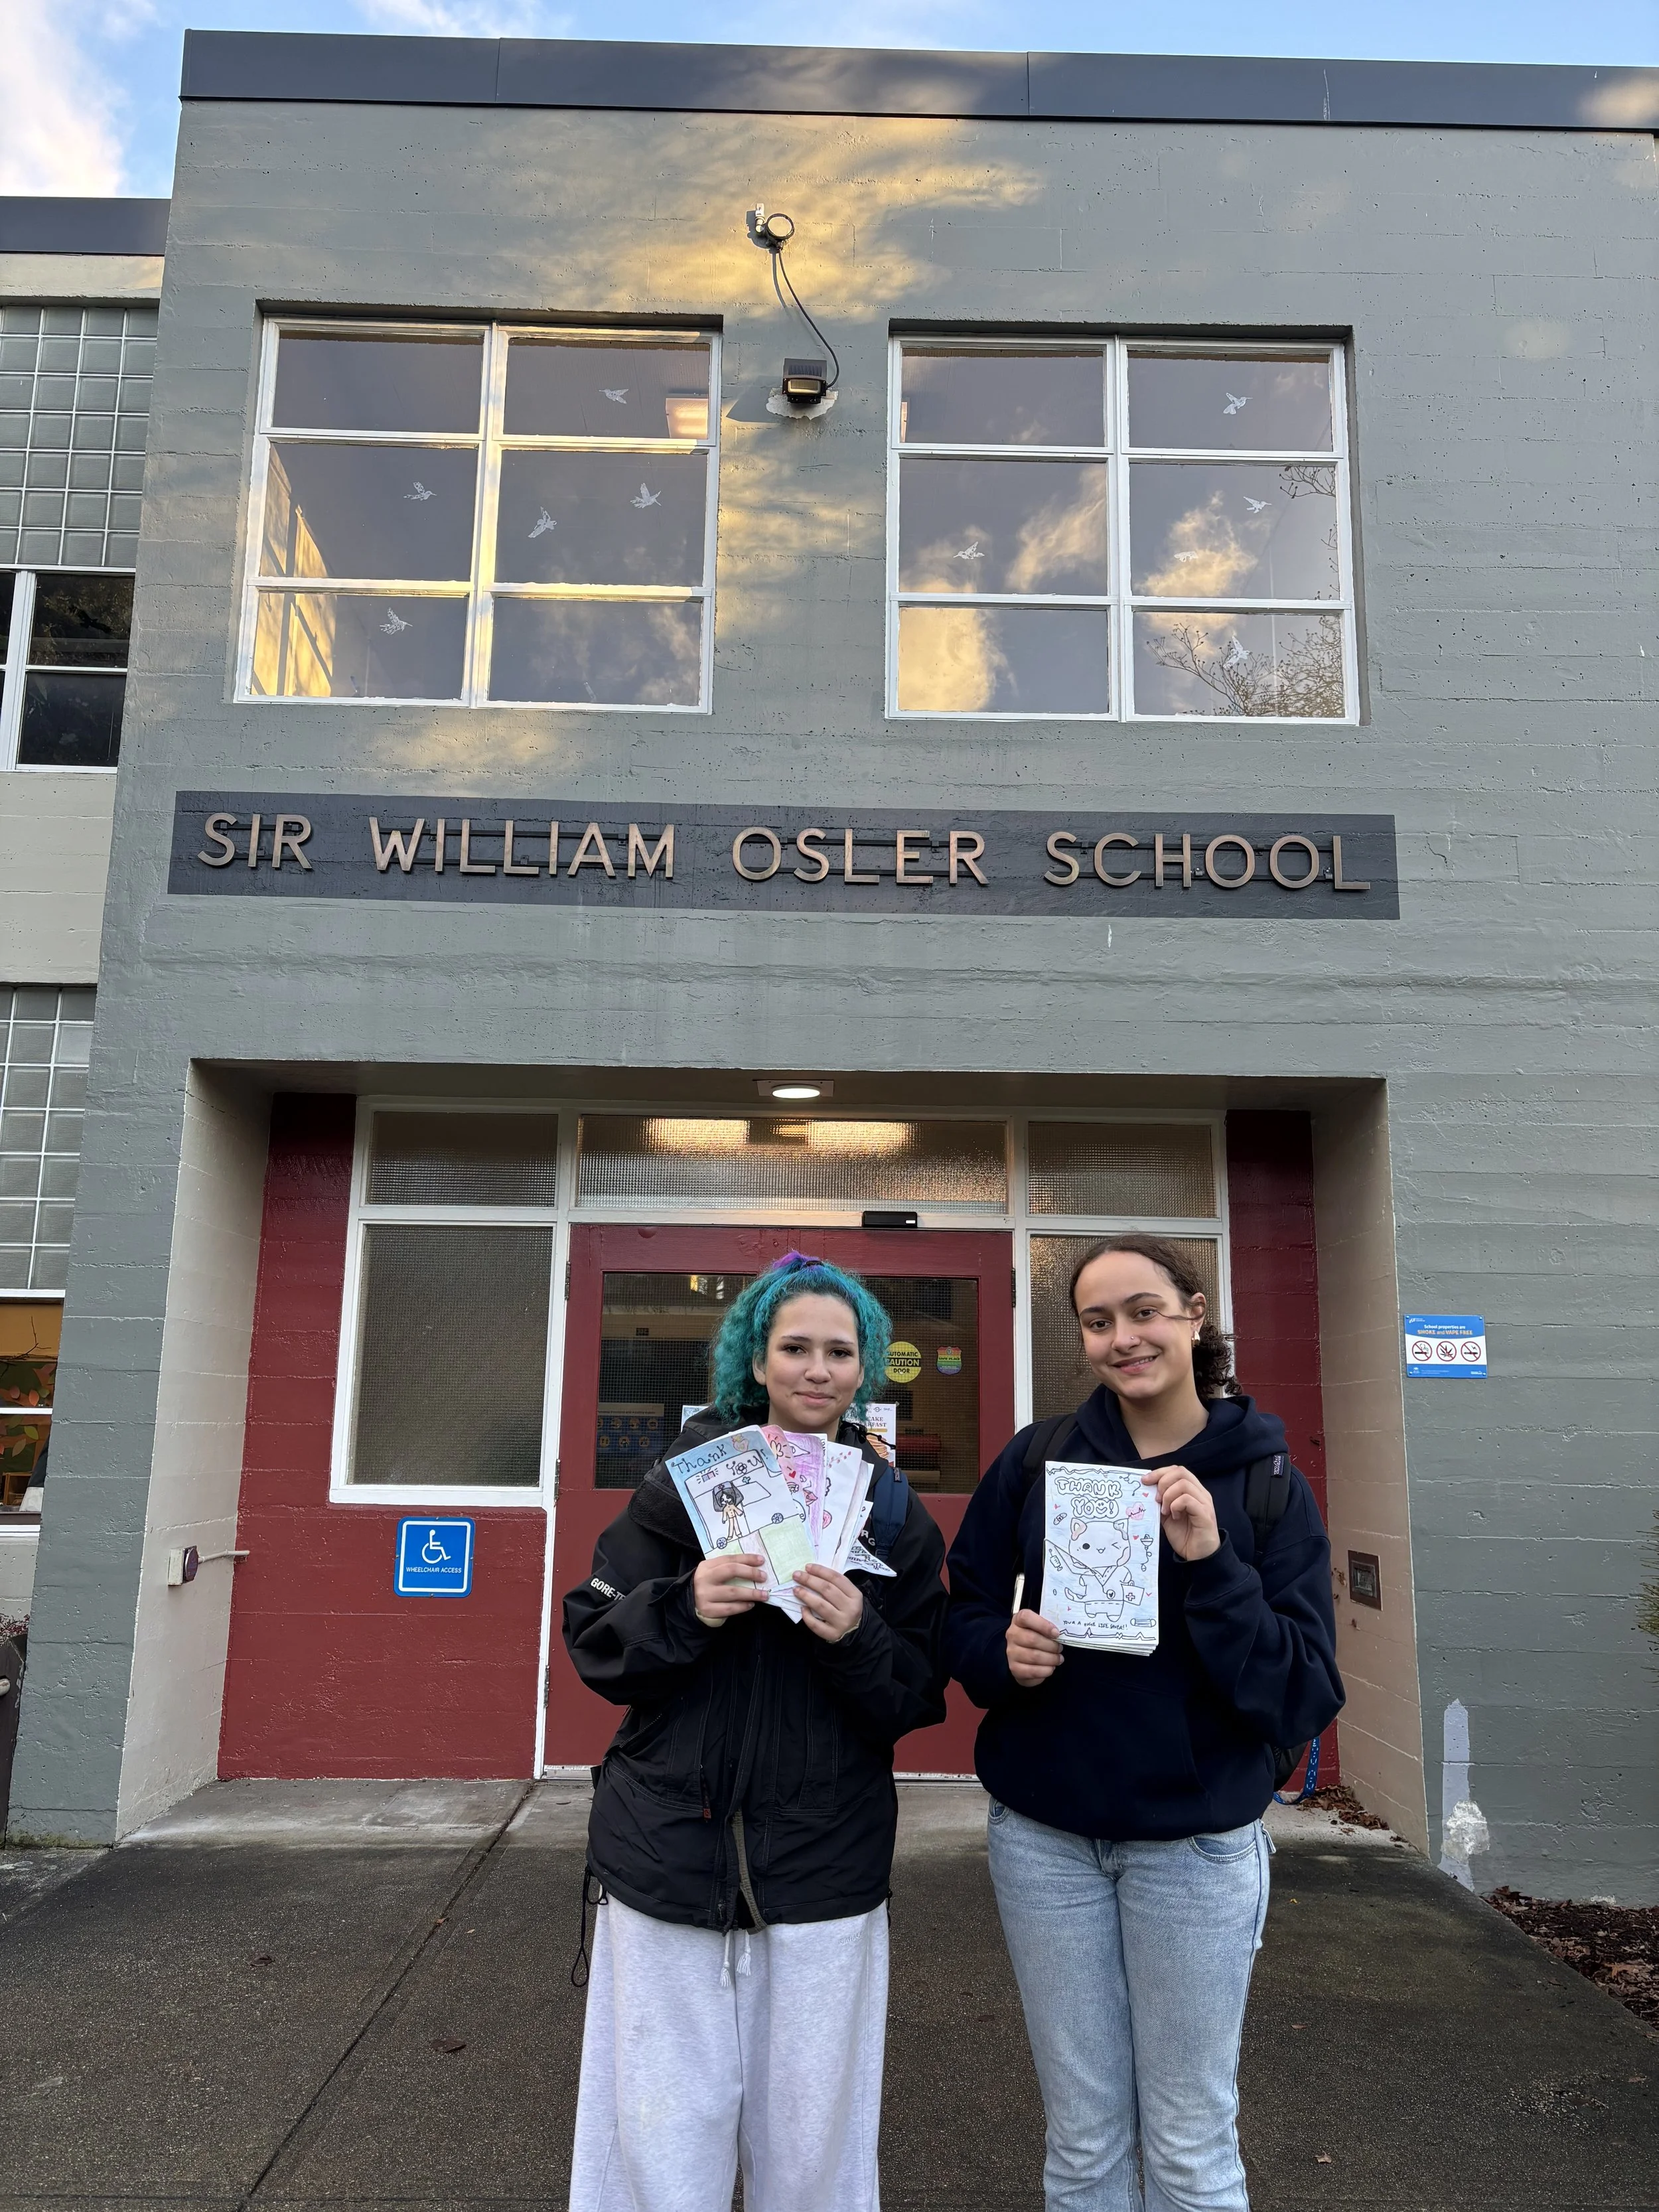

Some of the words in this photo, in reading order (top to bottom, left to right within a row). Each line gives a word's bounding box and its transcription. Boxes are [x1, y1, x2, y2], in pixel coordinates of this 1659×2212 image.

[197, 812, 313, 869] SIR
[368, 816, 675, 879] WILLIAM
[731, 826, 989, 886] OSLER
[1043, 832, 1370, 891] SCHOOL
[671, 1444, 727, 1473] Thank
[1057, 1479, 1119, 1497] THANK
